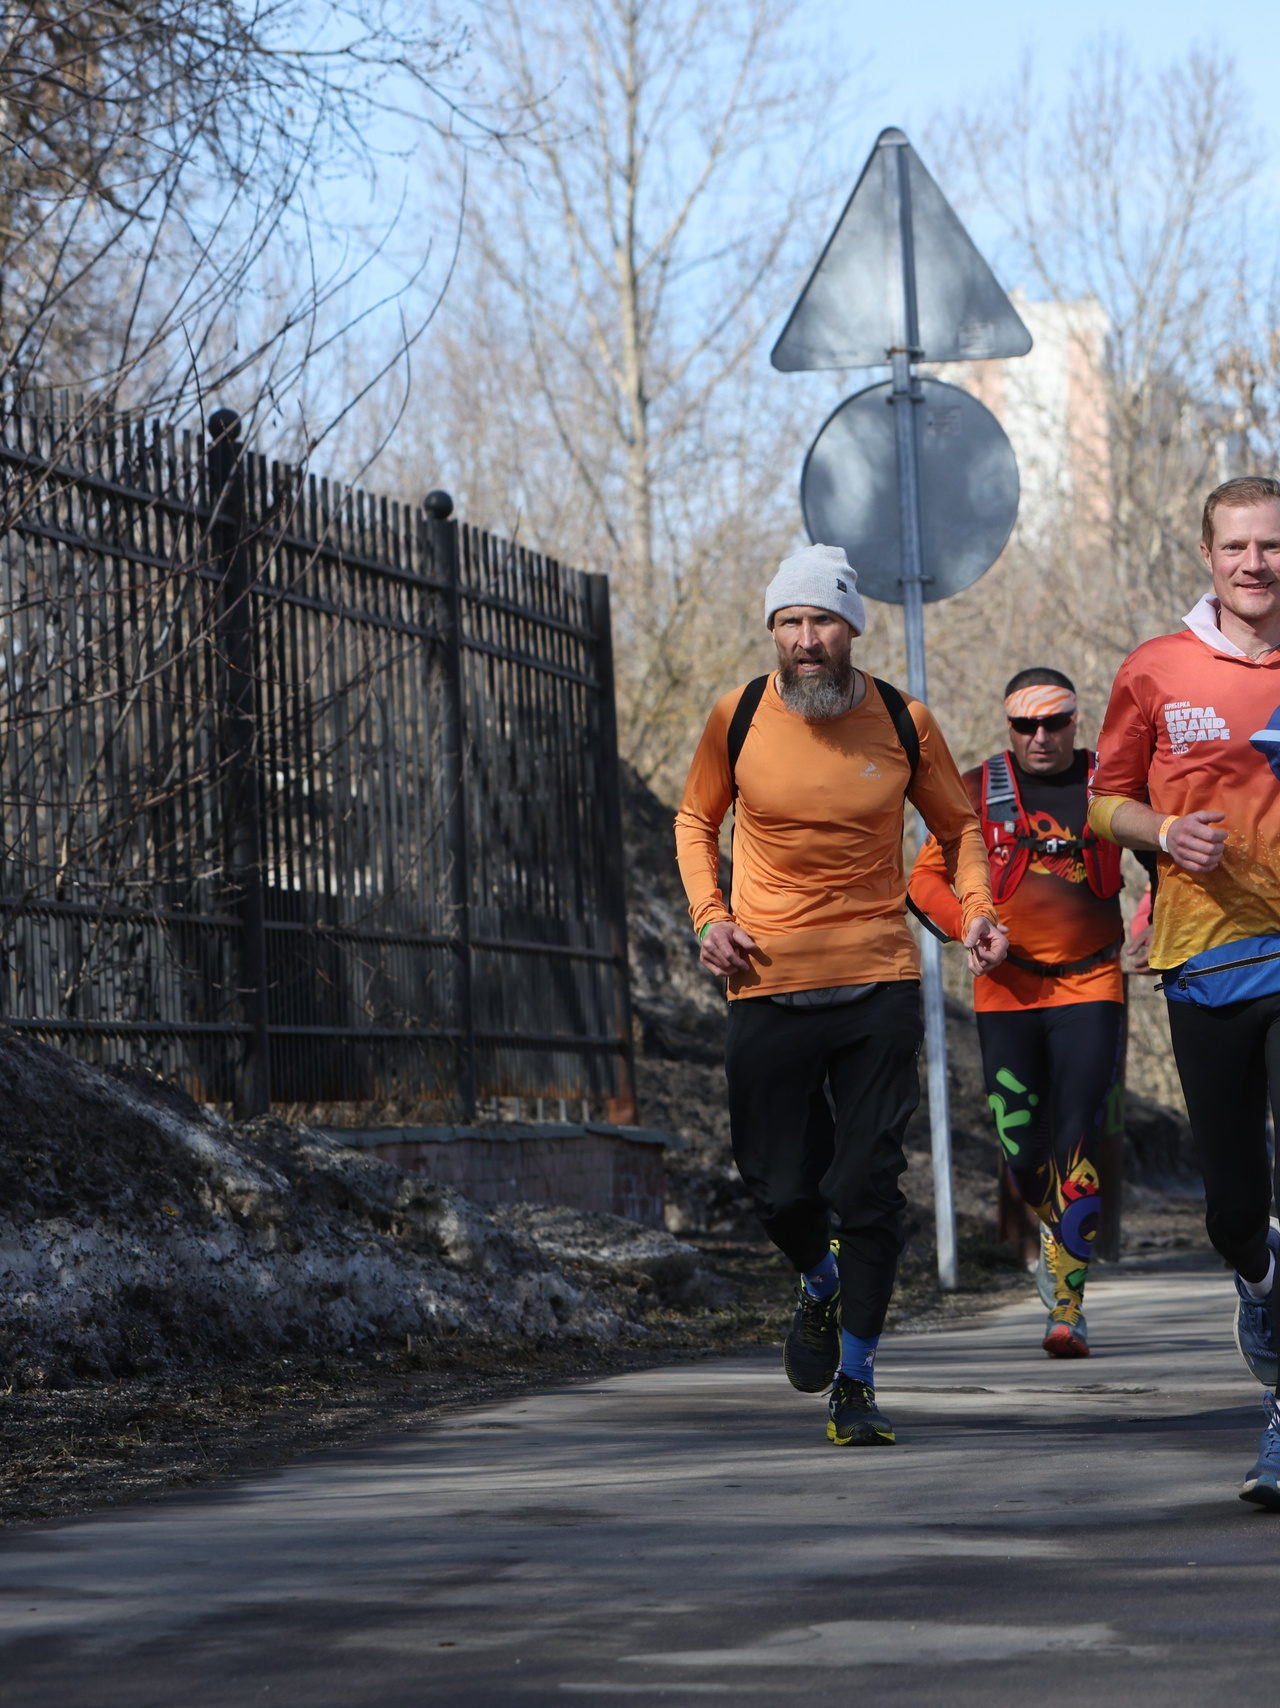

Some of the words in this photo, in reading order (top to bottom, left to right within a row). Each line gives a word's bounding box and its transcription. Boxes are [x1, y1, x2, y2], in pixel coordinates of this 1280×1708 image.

[1164, 706, 1216, 722] ULTRA
[1167, 717, 1226, 733] GRAND
[1169, 728, 1231, 744] ESCAPE
[1170, 743, 1189, 754] 2025
